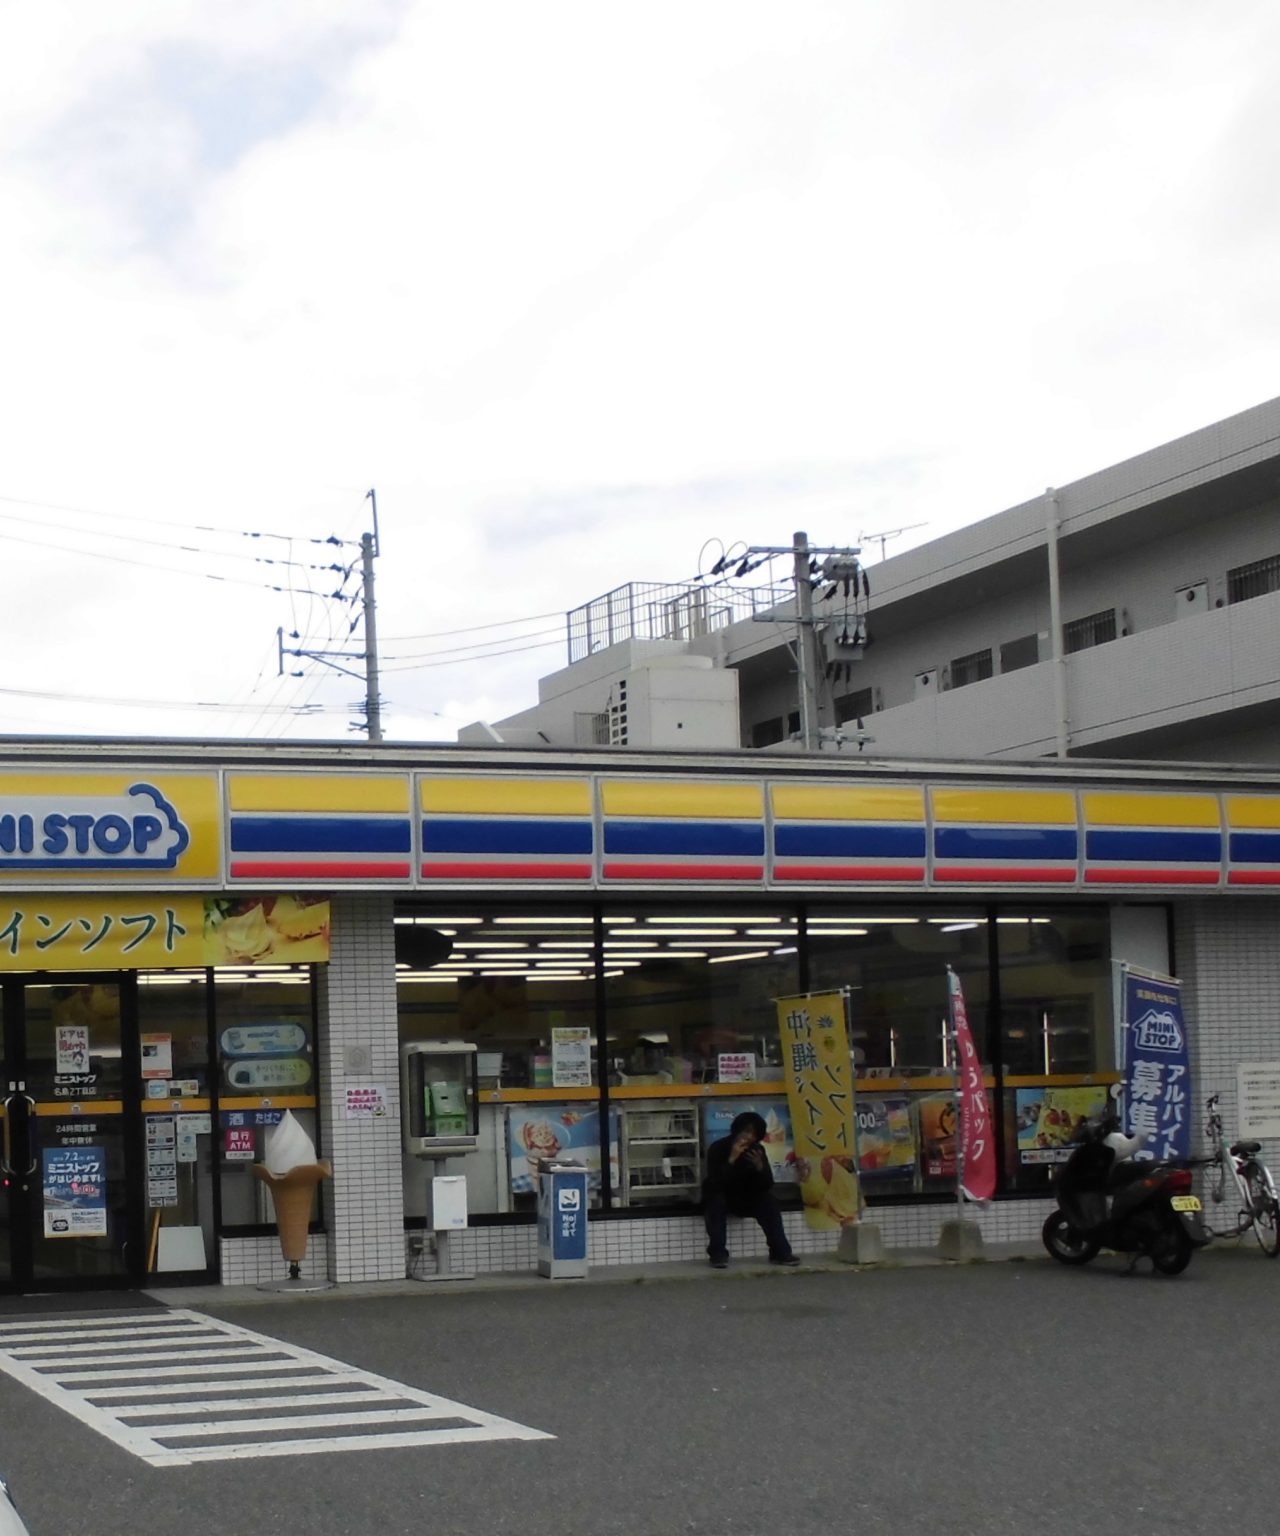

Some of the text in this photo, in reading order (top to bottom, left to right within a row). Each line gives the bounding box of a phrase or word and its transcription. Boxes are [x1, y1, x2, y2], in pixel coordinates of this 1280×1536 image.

[42, 813, 161, 855] STOP
[1147, 1020, 1175, 1035] MINI
[1144, 1032, 1177, 1046] STOP
[54, 1074, 97, 1084] ミニストップ
[1160, 1063, 1186, 1160] アルバイト
[228, 1112, 281, 1126] 酒 たばこ
[230, 1141, 251, 1150] ATM
[47, 1162, 100, 1174] ミニストップ
